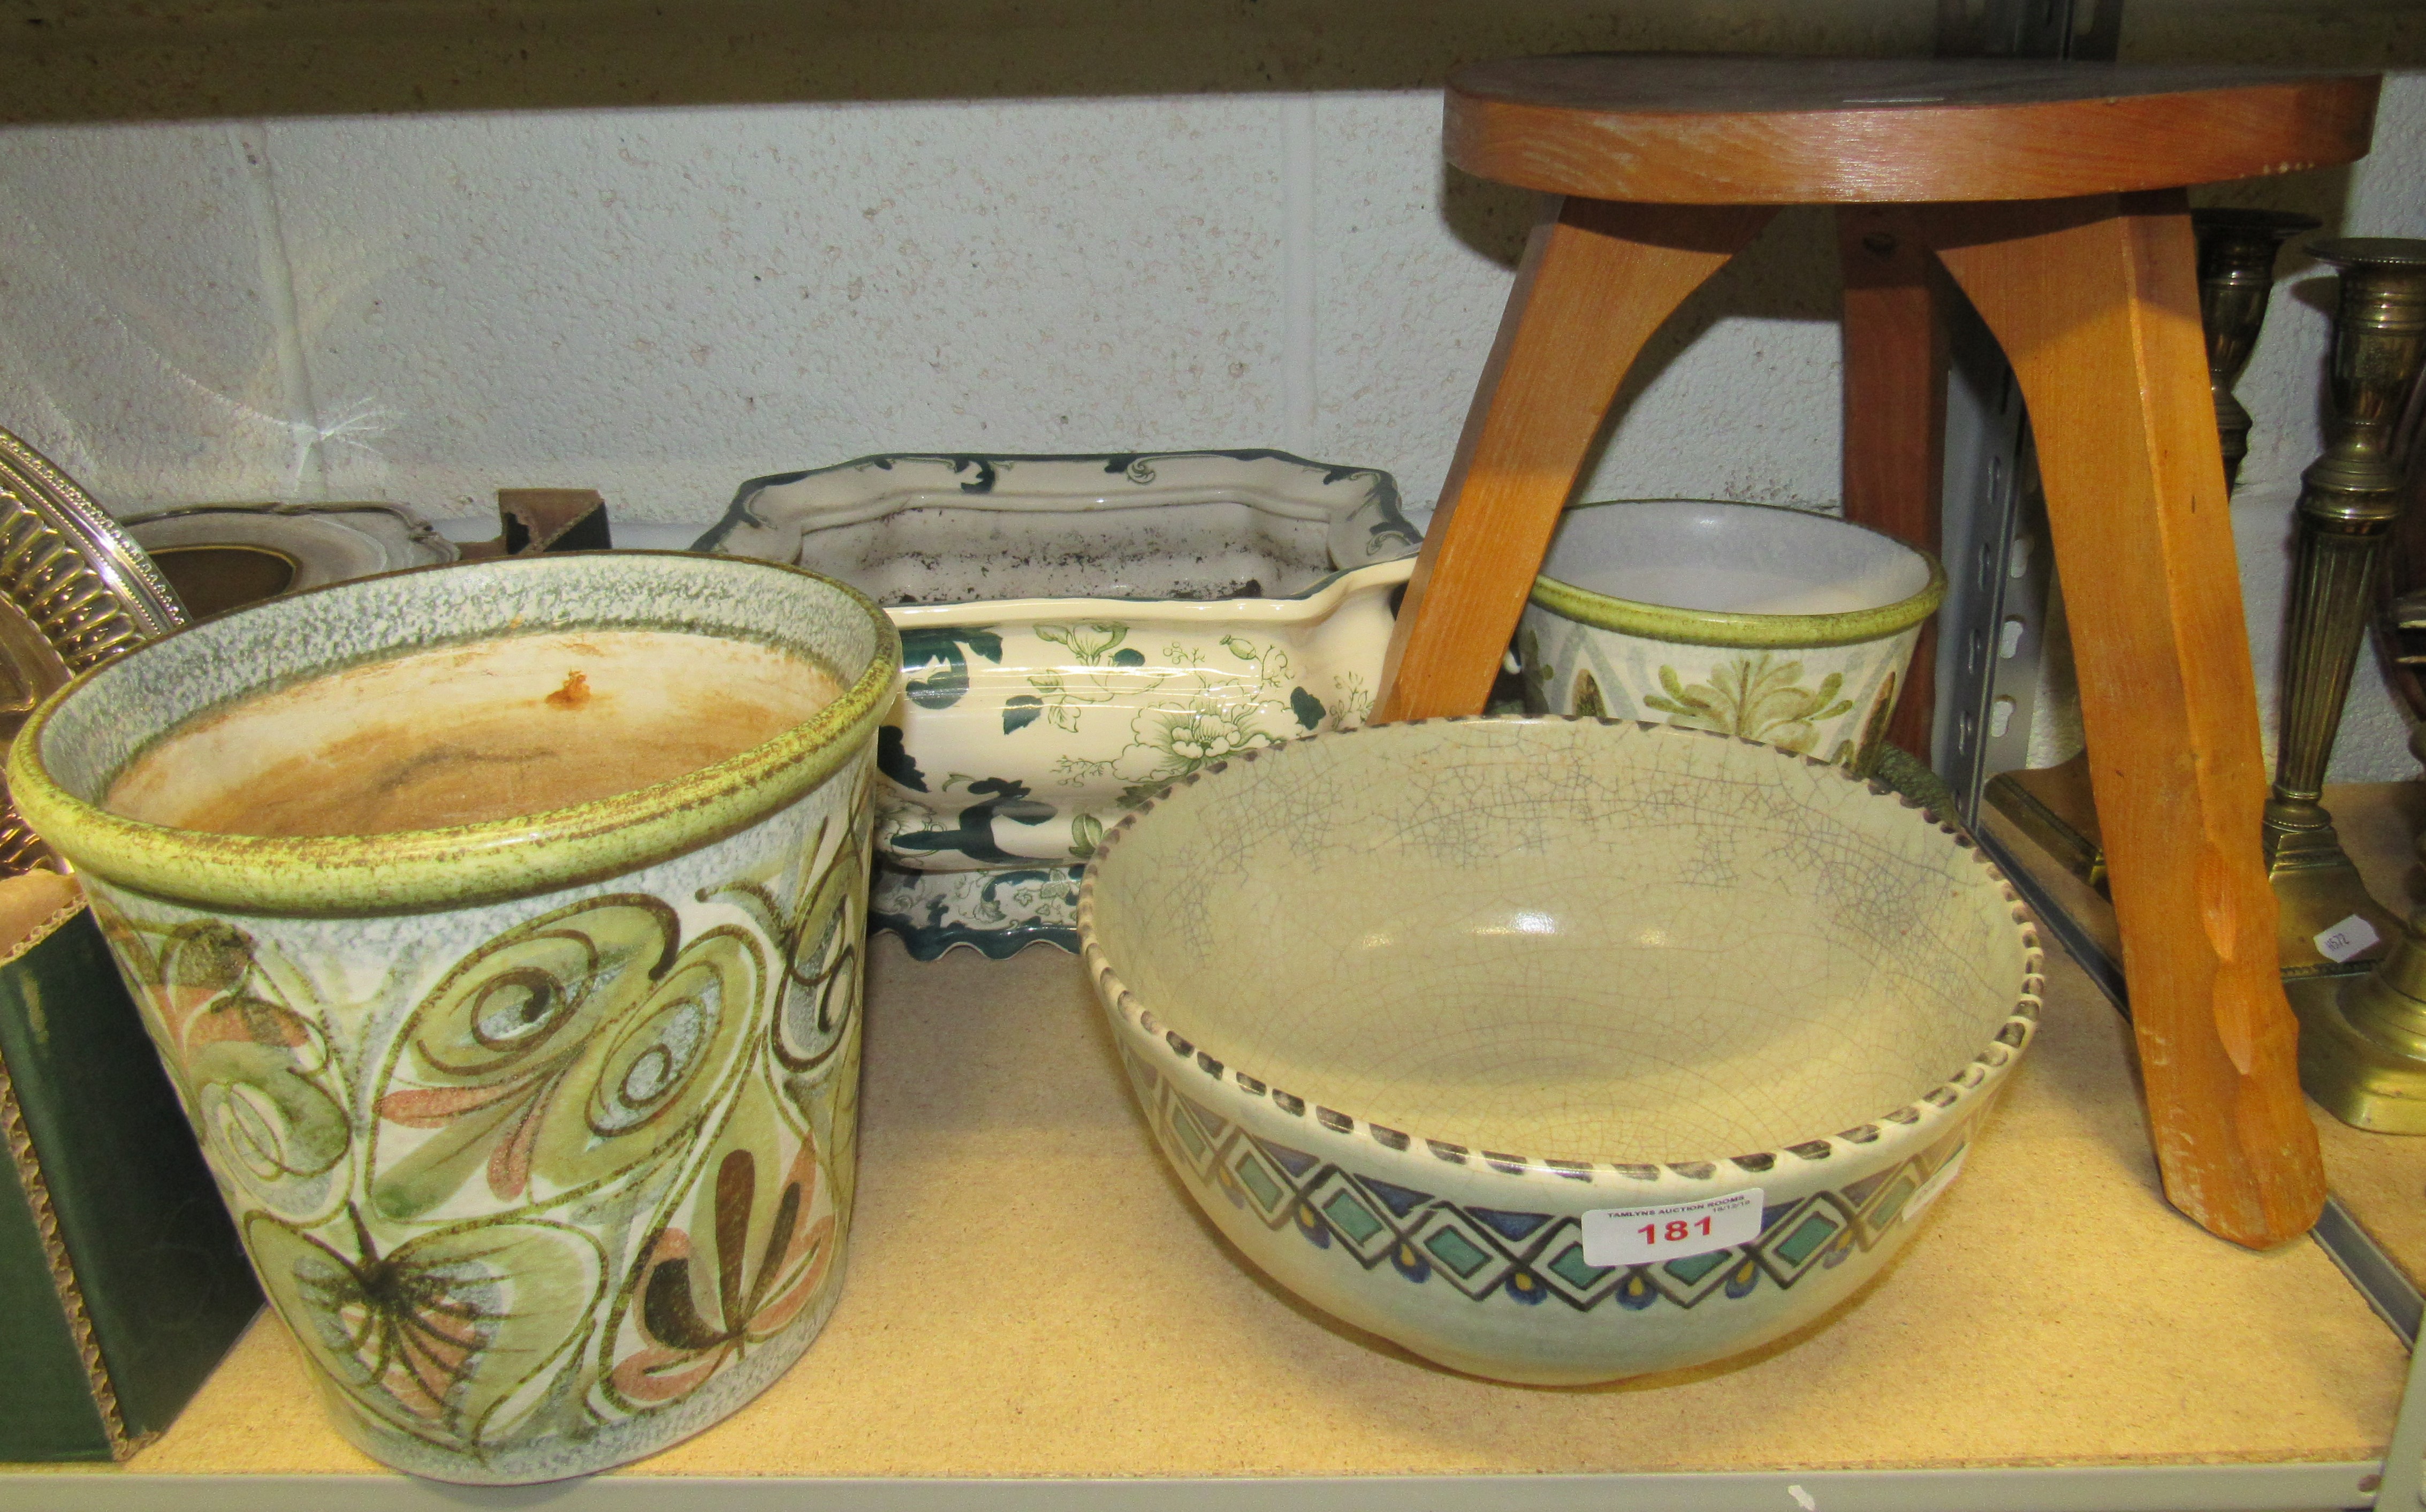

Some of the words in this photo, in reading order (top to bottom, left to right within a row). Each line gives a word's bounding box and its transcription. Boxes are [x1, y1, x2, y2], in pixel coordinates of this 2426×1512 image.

[1607, 1210, 1655, 1218] TAMLYNS
[1658, 1203, 1705, 1215] AUCTION
[1707, 1195, 1745, 1207] ROOMS
[1638, 1216, 1712, 1245] 181
